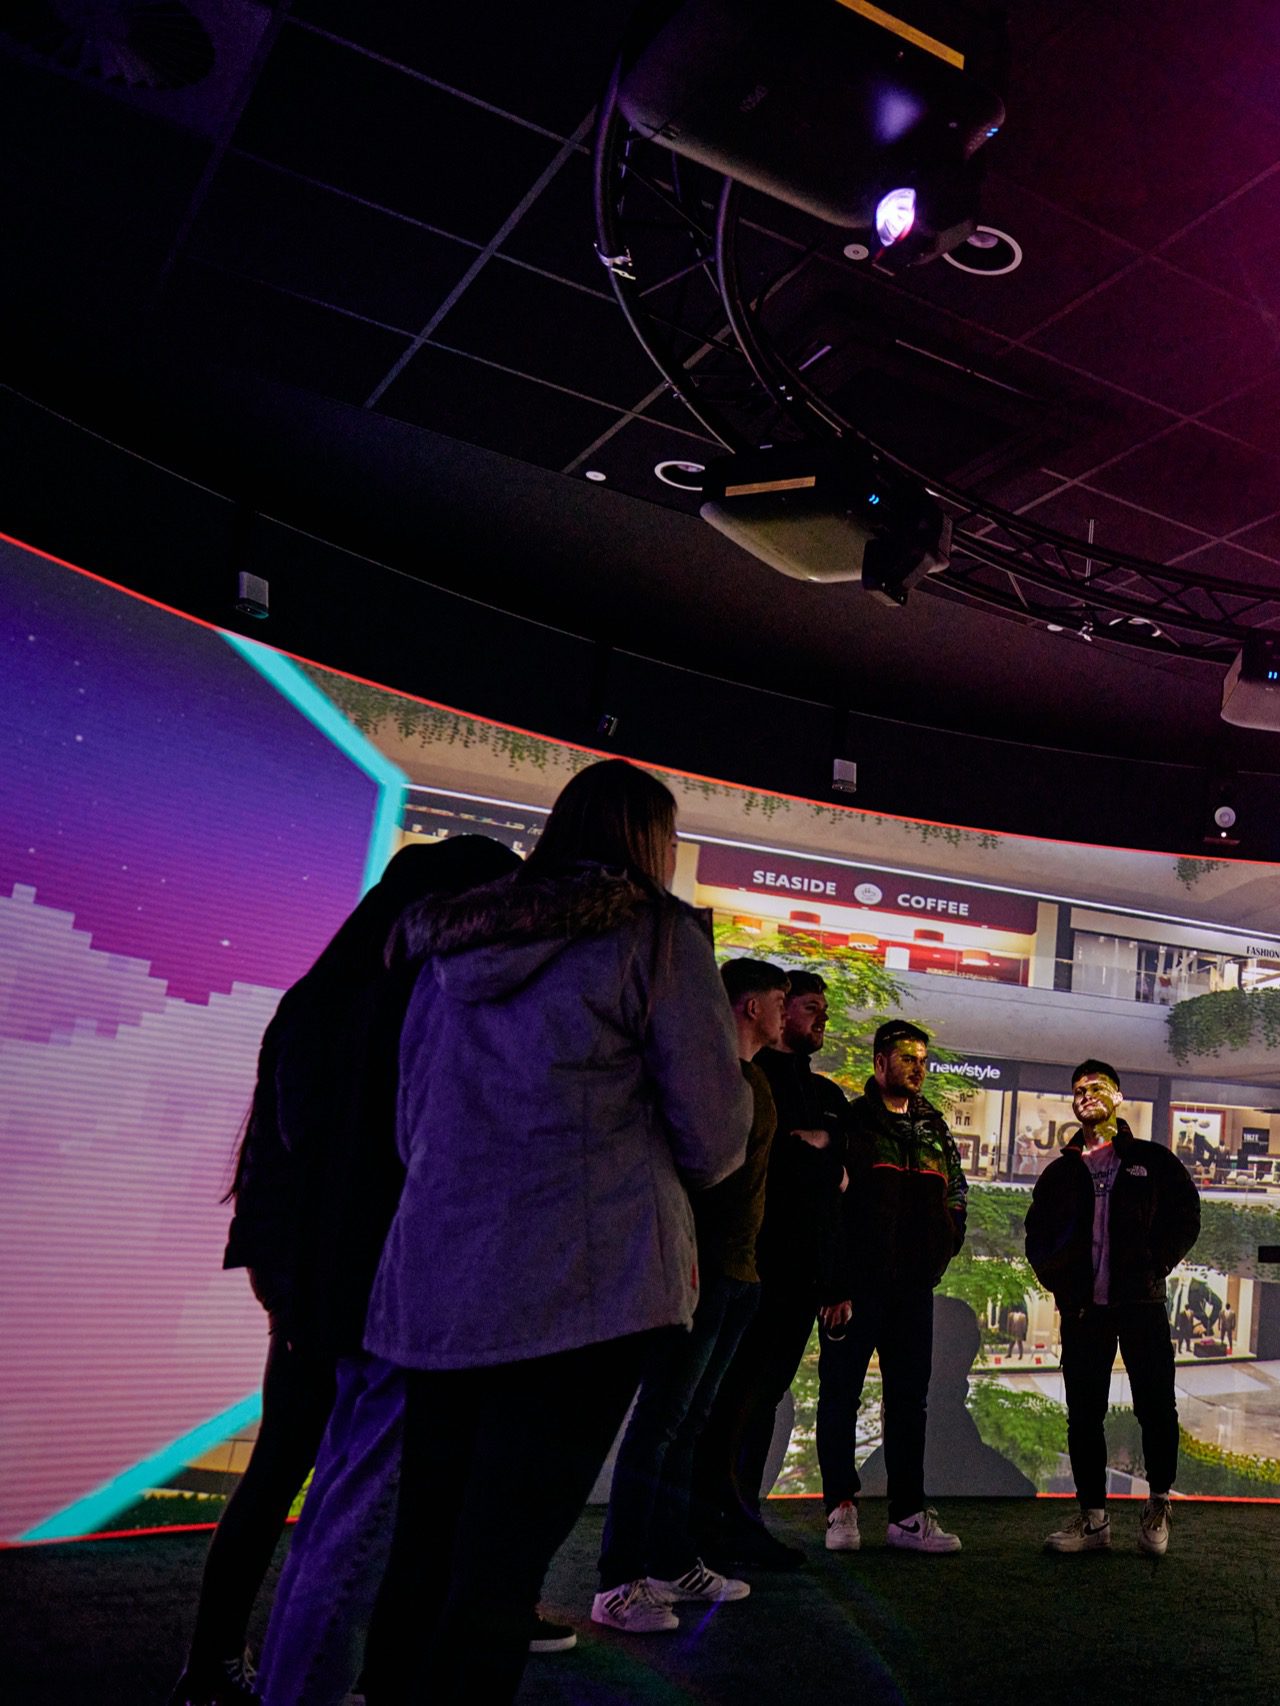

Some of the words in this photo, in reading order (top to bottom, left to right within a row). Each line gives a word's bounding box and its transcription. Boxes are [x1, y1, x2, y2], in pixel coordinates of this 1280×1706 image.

[753, 870, 837, 896] SEASIDE
[897, 893, 970, 917] COFFEE
[1246, 945, 1280, 959] FASHION
[929, 1061, 1001, 1080] new/style
